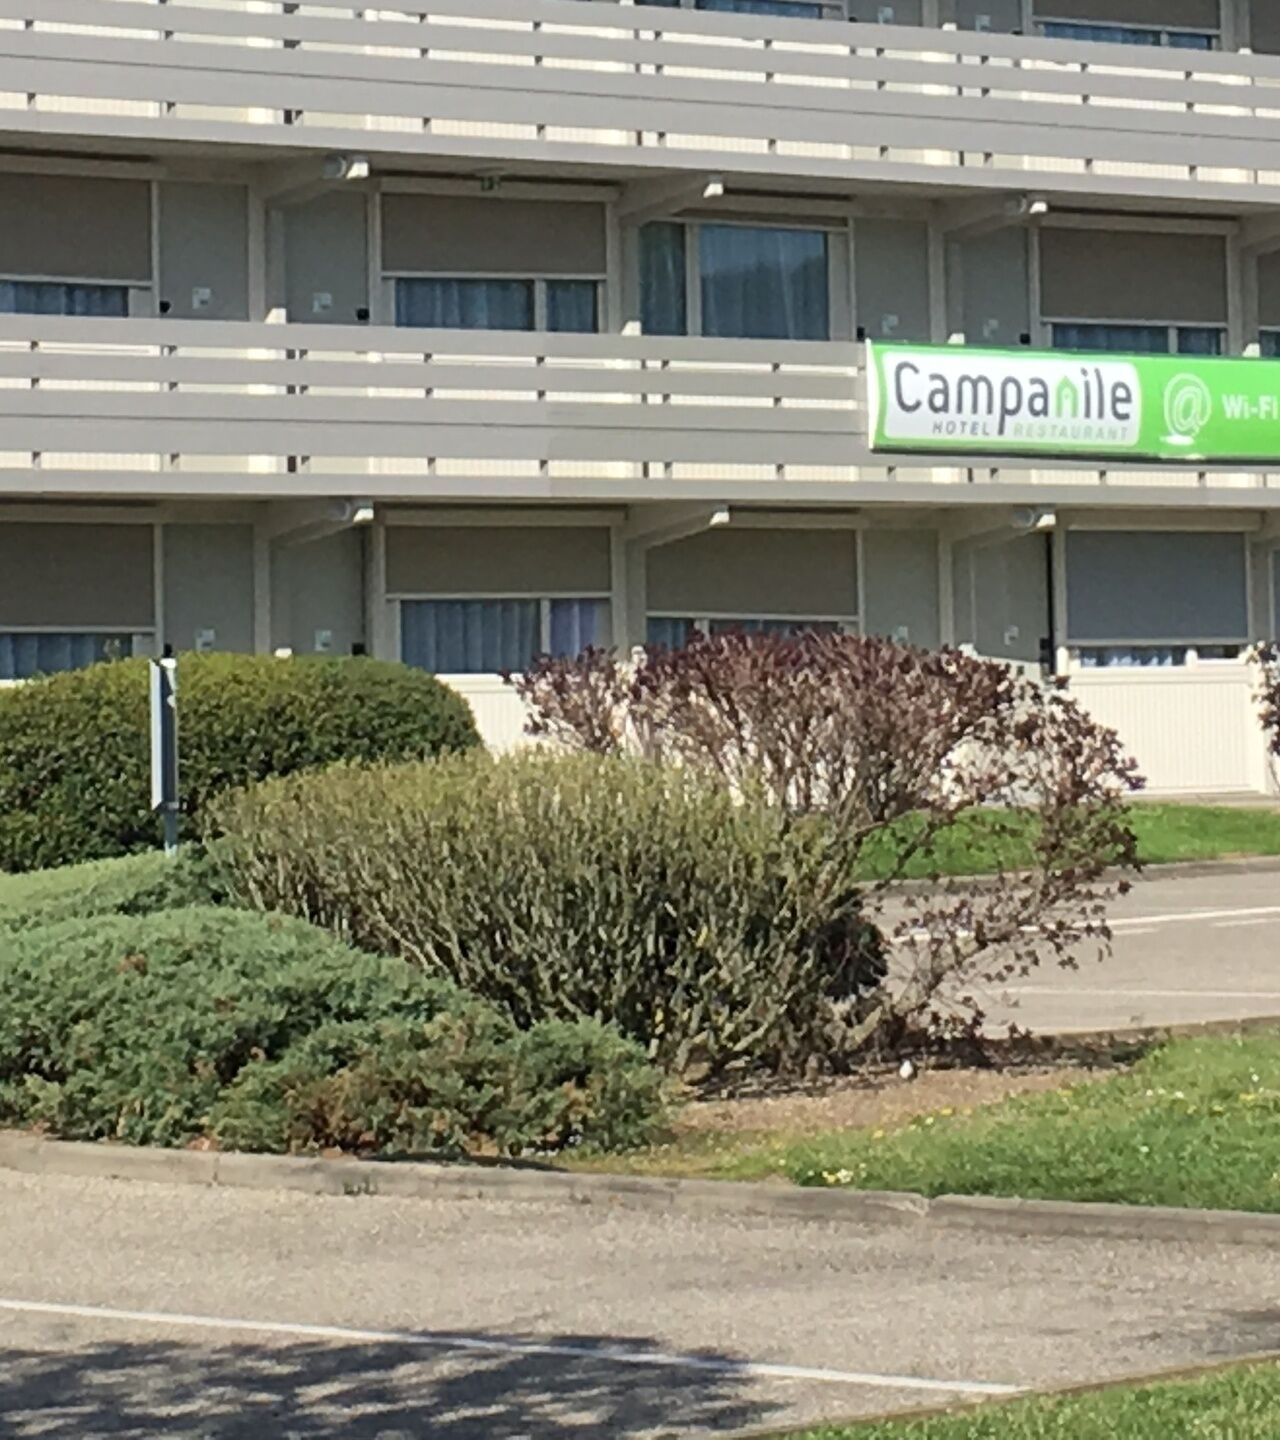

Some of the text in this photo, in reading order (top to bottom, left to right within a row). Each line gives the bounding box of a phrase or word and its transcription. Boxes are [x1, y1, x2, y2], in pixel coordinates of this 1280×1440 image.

[895, 361, 1132, 435] Campanile
[932, 420, 1129, 441] HOTEL RESTAURANT
